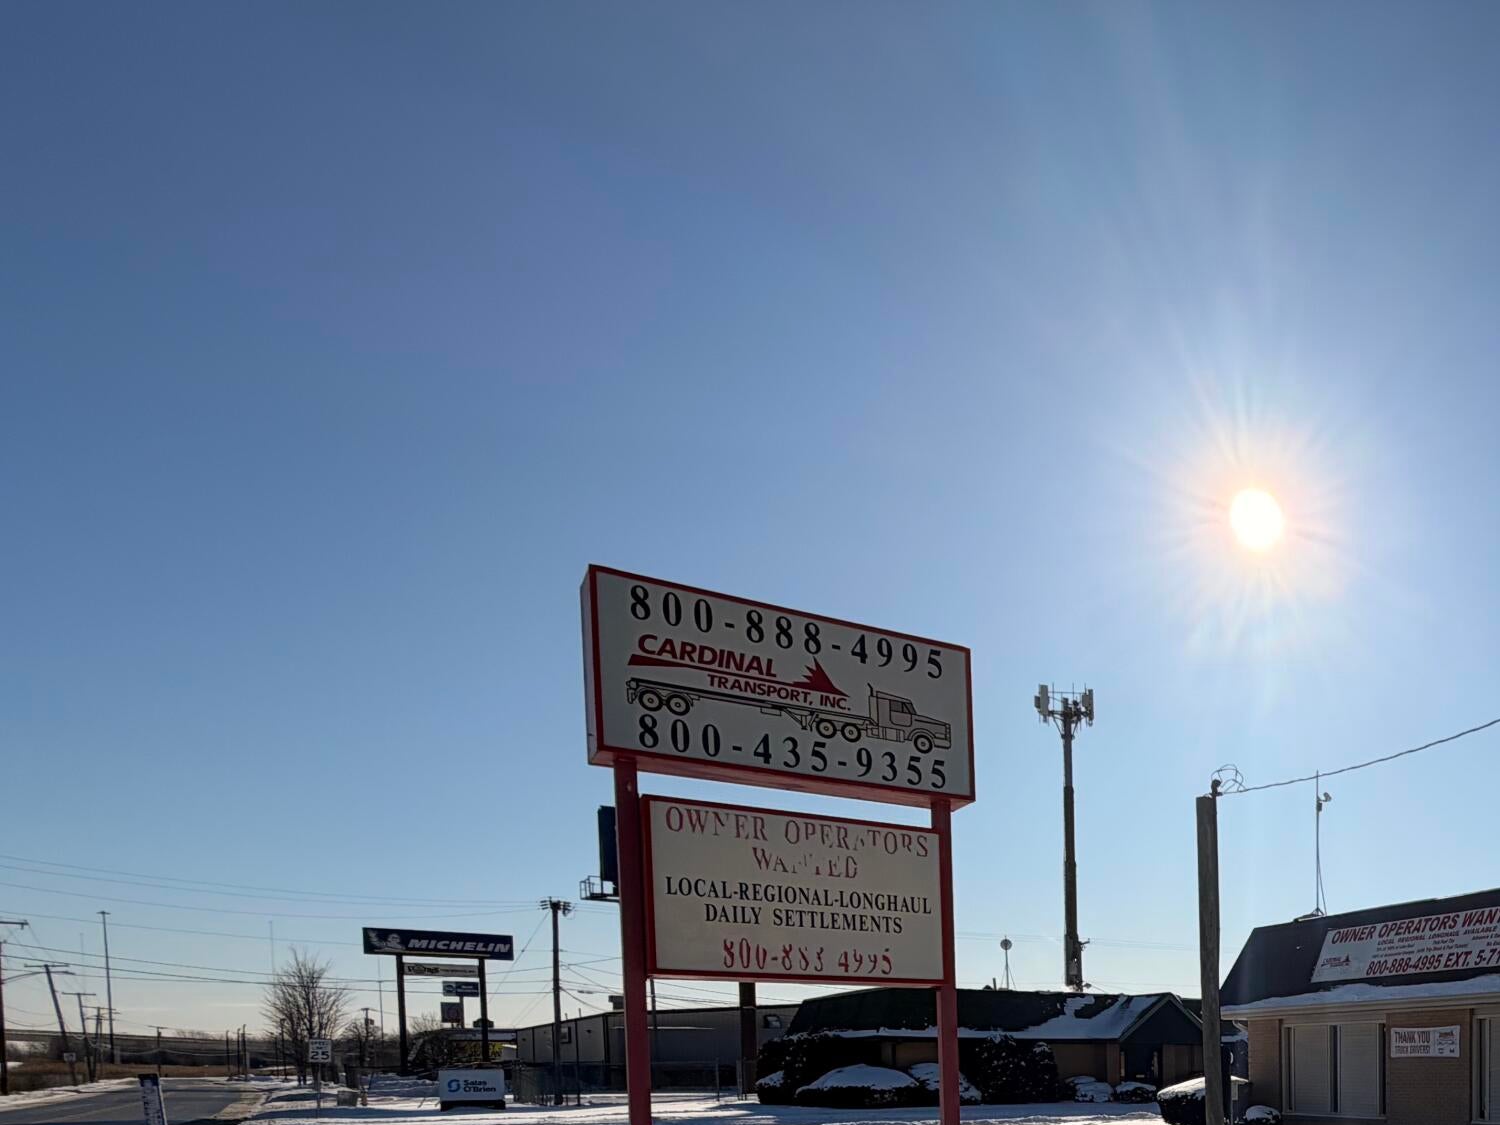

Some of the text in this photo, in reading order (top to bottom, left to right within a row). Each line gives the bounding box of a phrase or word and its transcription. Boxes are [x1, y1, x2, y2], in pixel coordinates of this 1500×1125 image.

[630, 584, 943, 680] 800-888-4995
[637, 633, 777, 678] CARDINAL
[820, 695, 851, 712] INC.
[638, 713, 946, 789] 800-435-9355
[665, 806, 769, 842] OWNER
[751, 846, 858, 879] WAED
[666, 876, 932, 915] LOCAL-REGIONAL-LONGHAUL
[705, 903, 903, 935] DAILY SETTLEMENTS
[1331, 925, 1377, 945] OWNER
[1378, 915, 1459, 939] OPERATORS
[408, 938, 511, 953] MICHELIN
[1366, 951, 1442, 977] 800-888-4995
[1444, 950, 1471, 969] EXT.
[1394, 1031, 1416, 1044] THANK
[1417, 1031, 1431, 1044] YOU
[311, 1050, 330, 1060] 25
